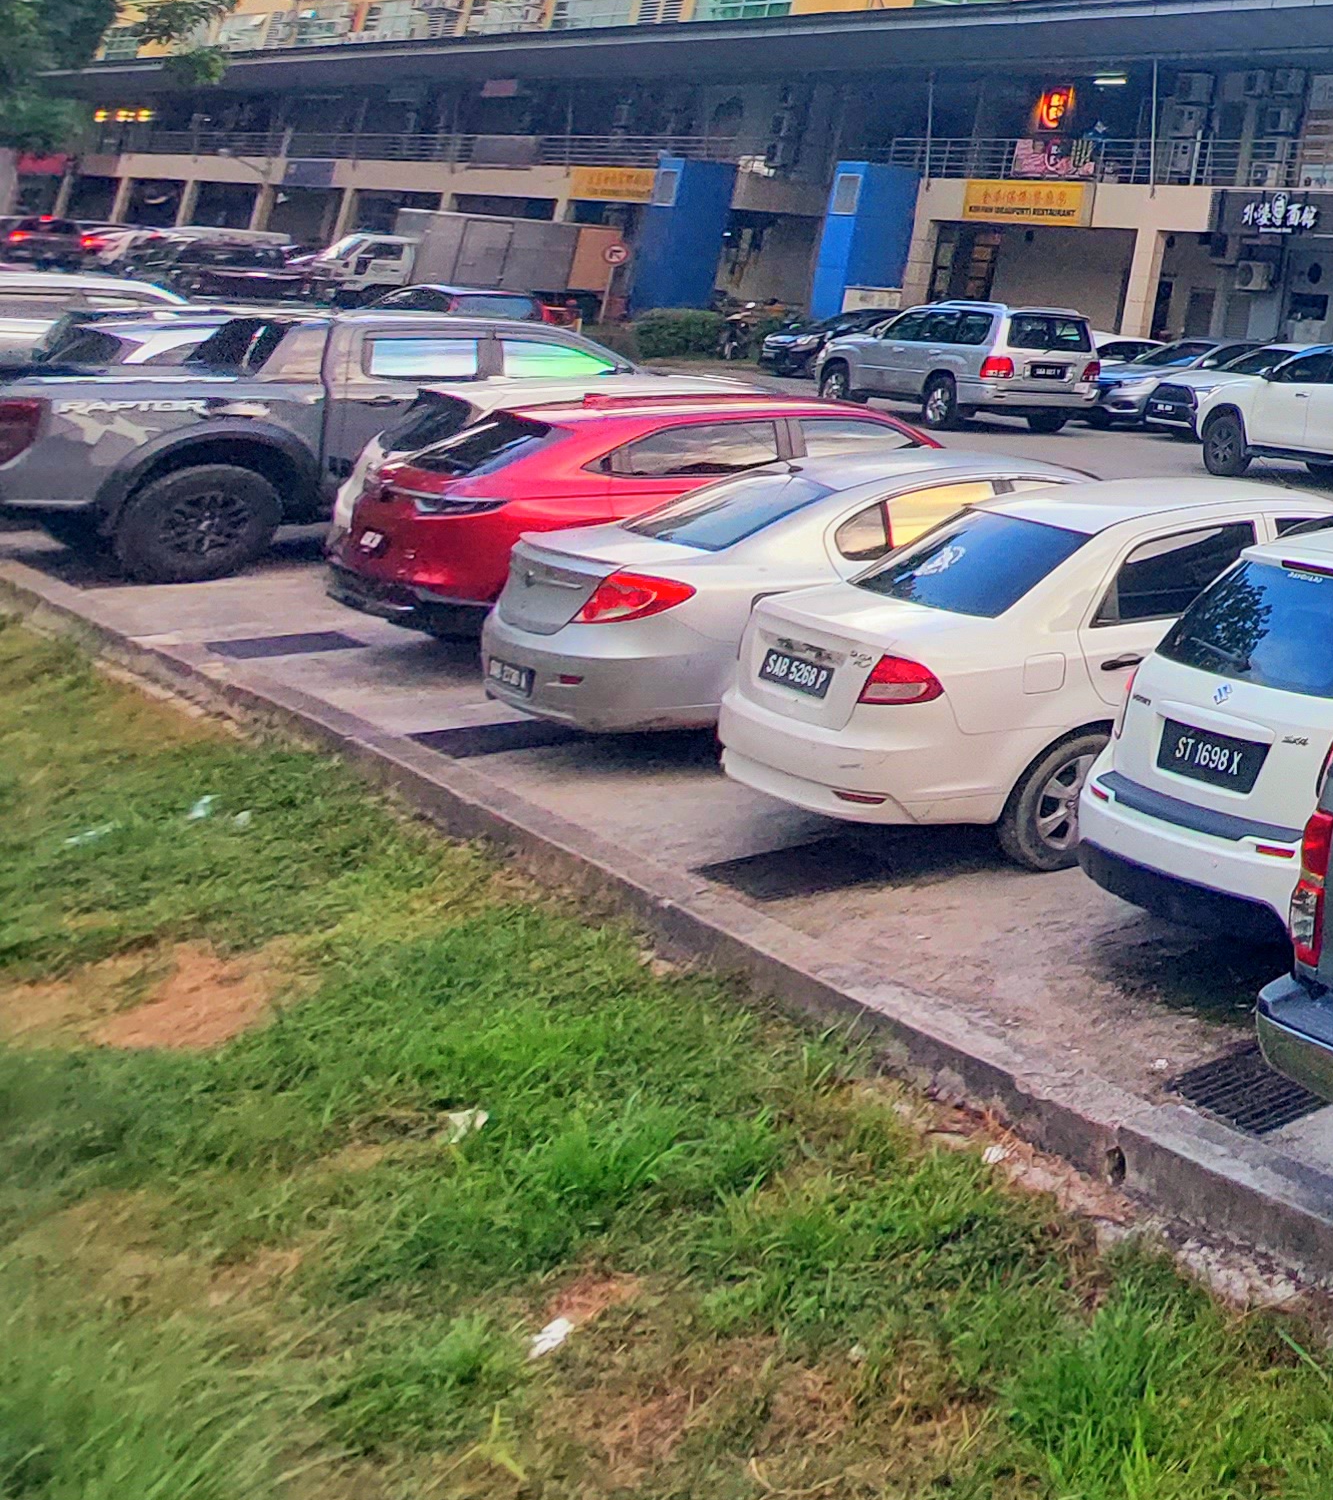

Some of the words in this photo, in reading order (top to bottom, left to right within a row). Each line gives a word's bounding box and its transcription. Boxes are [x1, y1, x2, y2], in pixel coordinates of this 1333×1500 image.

[55, 400, 210, 416] RAPTOR
[766, 654, 790, 678] SAB
[789, 661, 818, 687] 5268
[815, 669, 828, 689] P
[1175, 736, 1196, 761] ST
[1195, 741, 1229, 771] 1698
[1229, 751, 1243, 775] X
